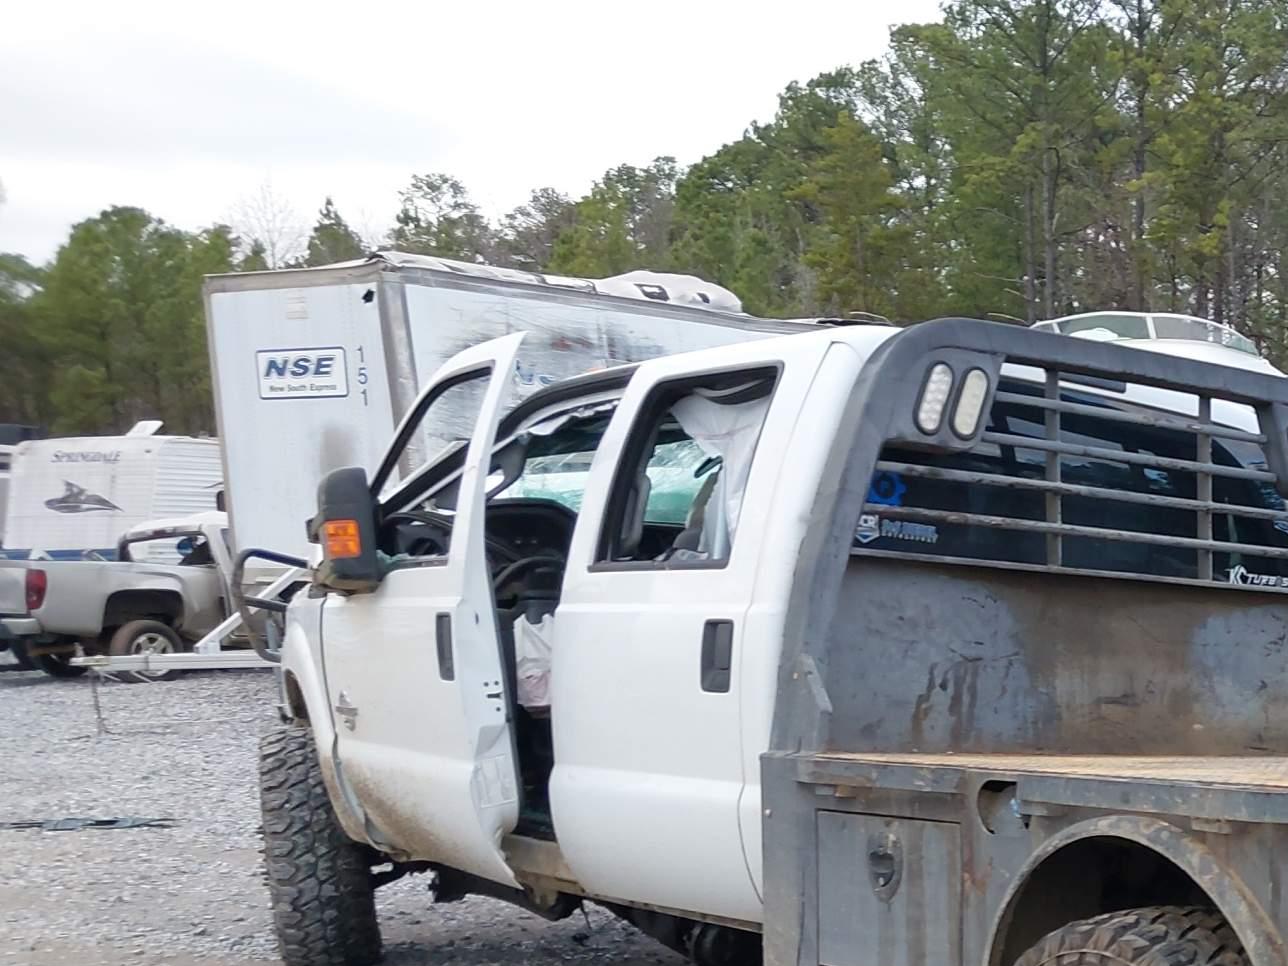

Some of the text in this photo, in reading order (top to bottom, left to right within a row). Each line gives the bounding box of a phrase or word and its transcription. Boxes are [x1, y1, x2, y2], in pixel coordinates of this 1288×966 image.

[264, 356, 335, 377] NSE
[288, 384, 306, 392] South
[310, 383, 337, 392] Express
